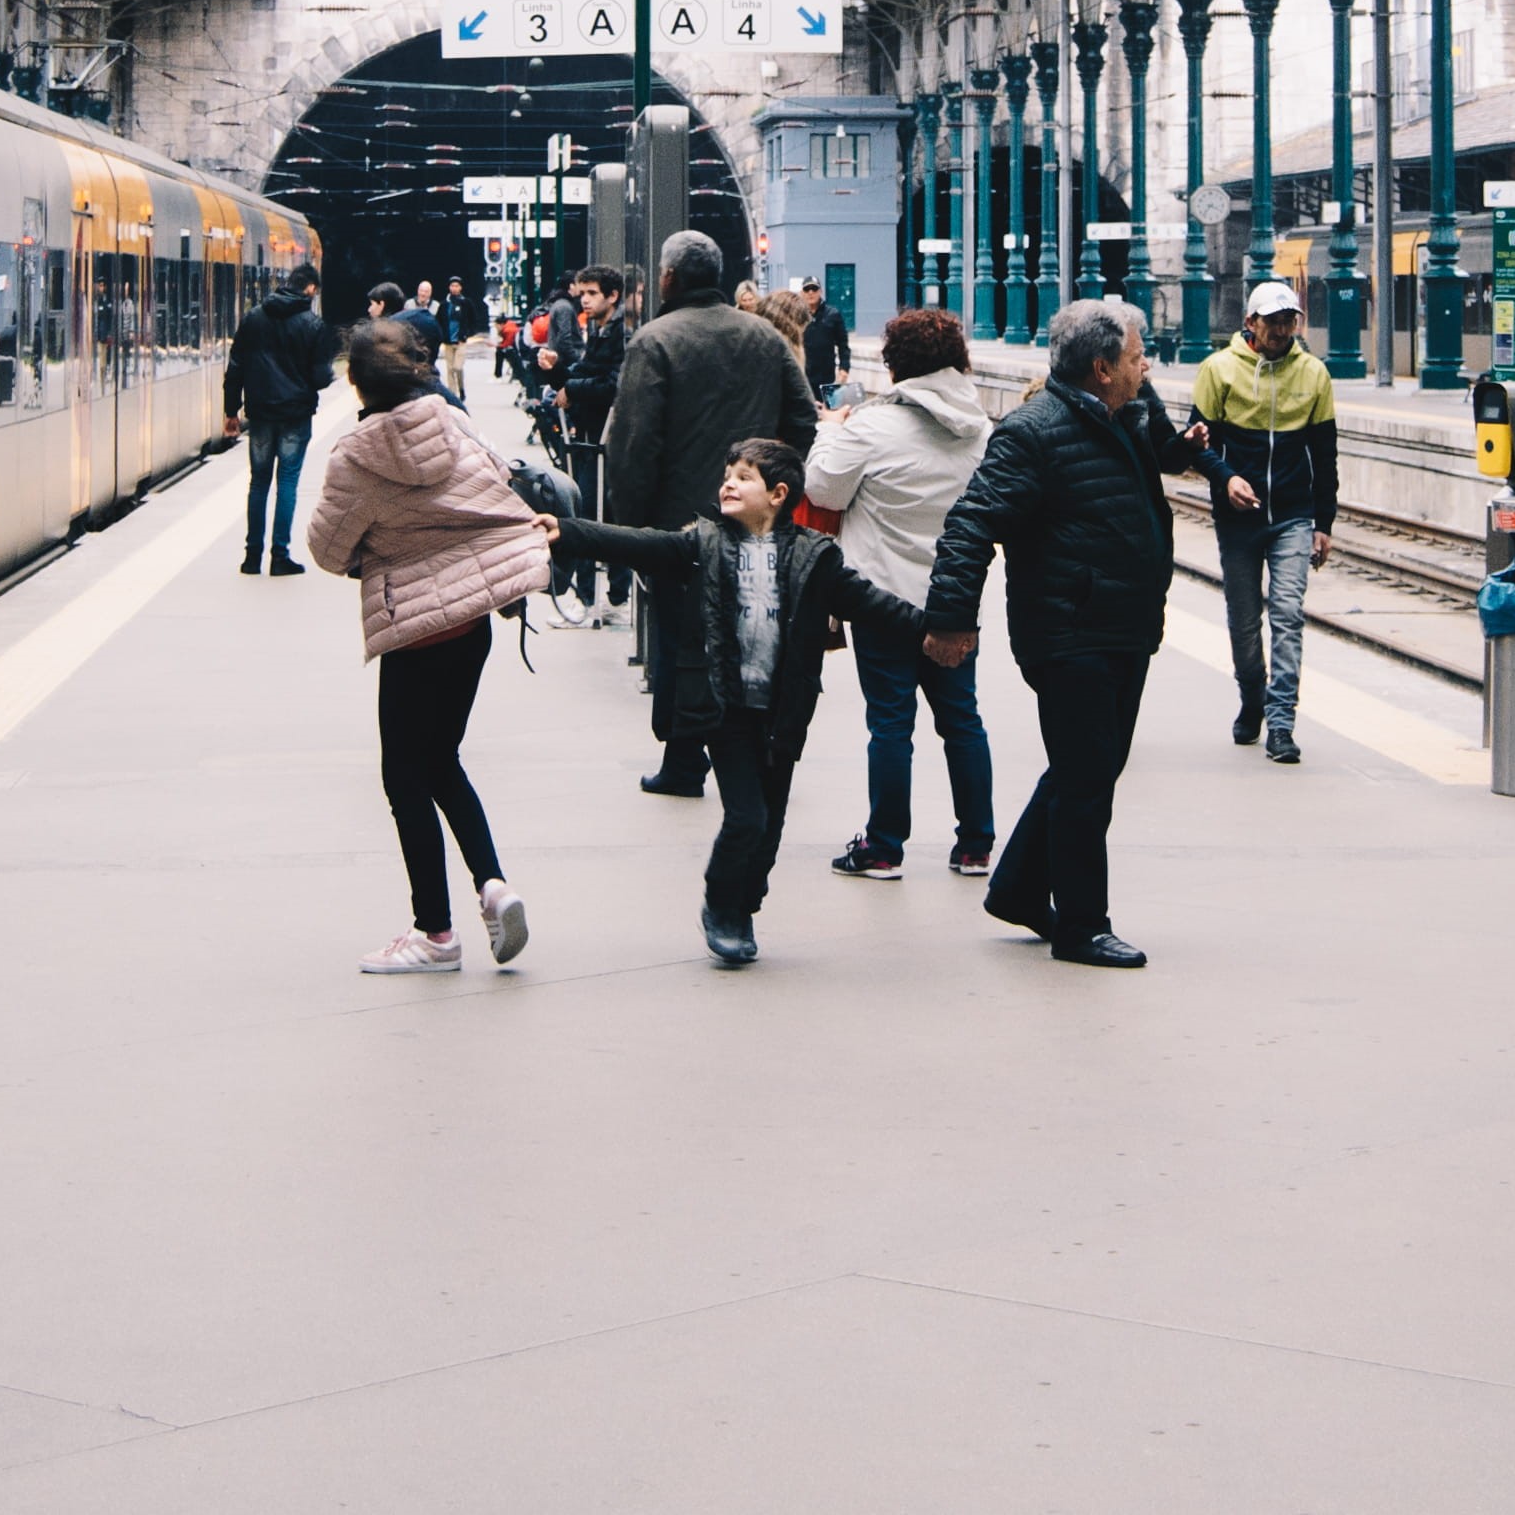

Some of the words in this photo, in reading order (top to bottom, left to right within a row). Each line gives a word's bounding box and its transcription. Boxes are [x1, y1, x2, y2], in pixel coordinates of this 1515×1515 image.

[529, 14, 548, 42] 3
[589, 9, 615, 36] A
[670, 8, 696, 35] A
[736, 13, 756, 40] 4
